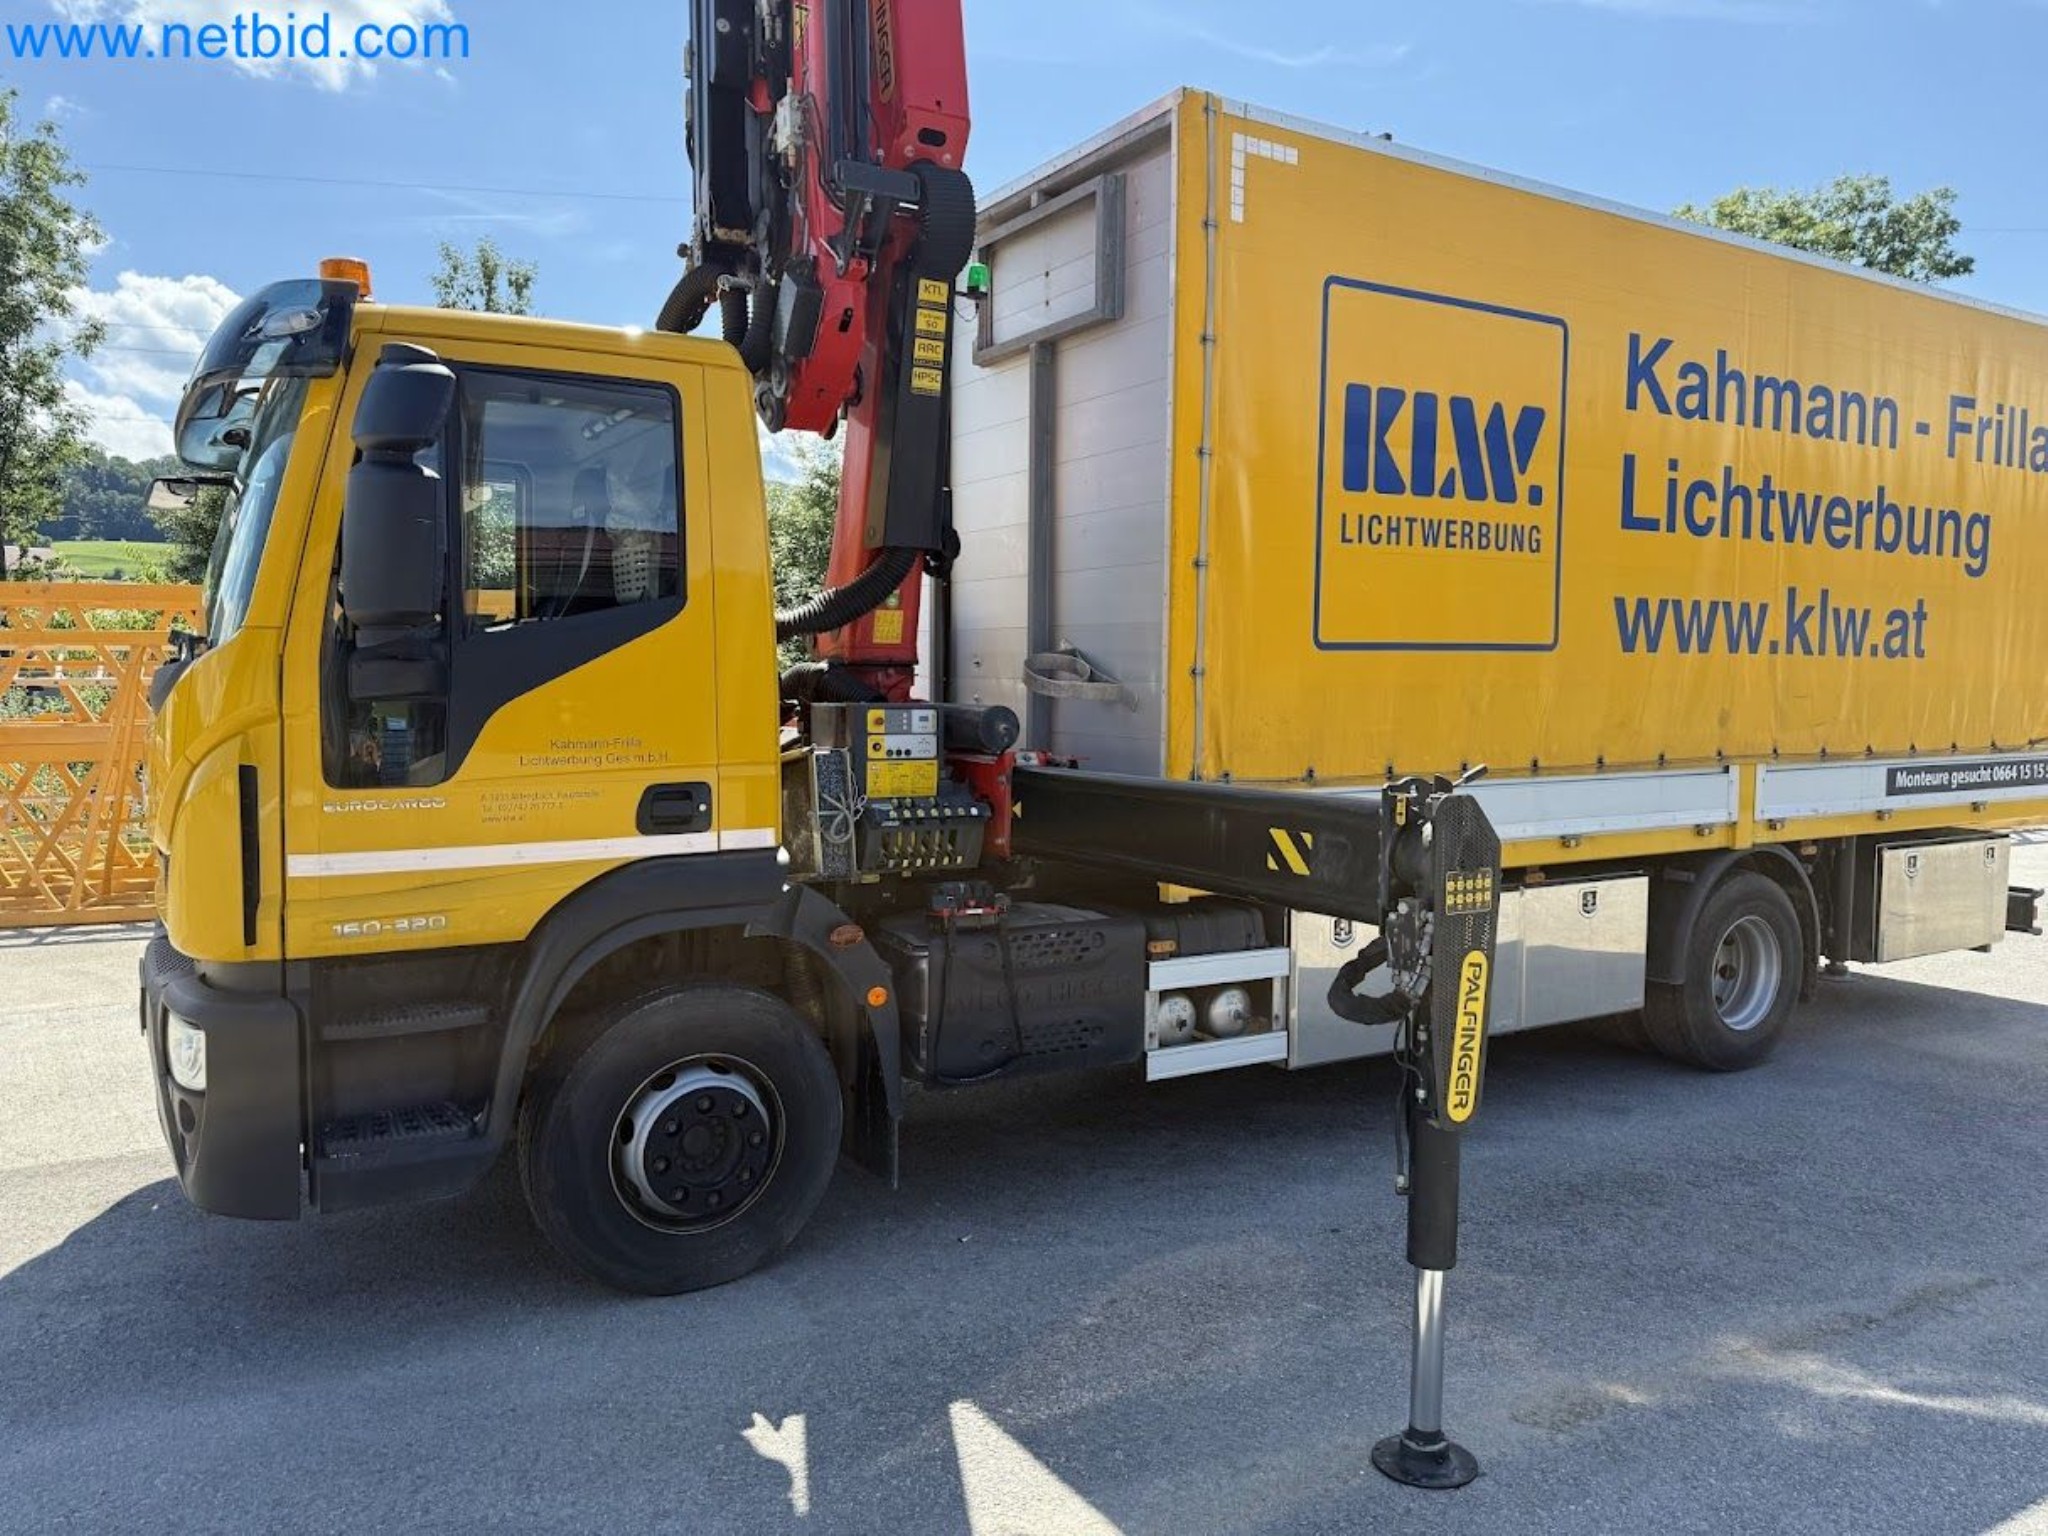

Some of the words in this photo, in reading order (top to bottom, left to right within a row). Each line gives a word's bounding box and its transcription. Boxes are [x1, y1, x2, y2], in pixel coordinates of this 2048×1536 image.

[875, 0, 892, 95] INGER
[1625, 332, 1899, 450] Kahmann
[1947, 393, 2048, 473] Frilla
[1341, 512, 1542, 554] LICHTWERBUNG
[1620, 452, 1991, 578] Lichtwerbung
[1613, 586, 1928, 659] www.klw.at
[519, 753, 603, 768] Lichtwerbung
[550, 738, 642, 752] Kahmann-Frilla
[1895, 768, 1950, 788] Monteure
[1951, 765, 1991, 789] gesucht
[1993, 764, 2018, 782] 0664
[2020, 763, 2031, 780] 15
[2033, 762, 2045, 779] 15
[322, 797, 446, 813] EUROCARGO
[332, 915, 446, 937] 160-320
[1452, 961, 1483, 1111] PALFINGER
